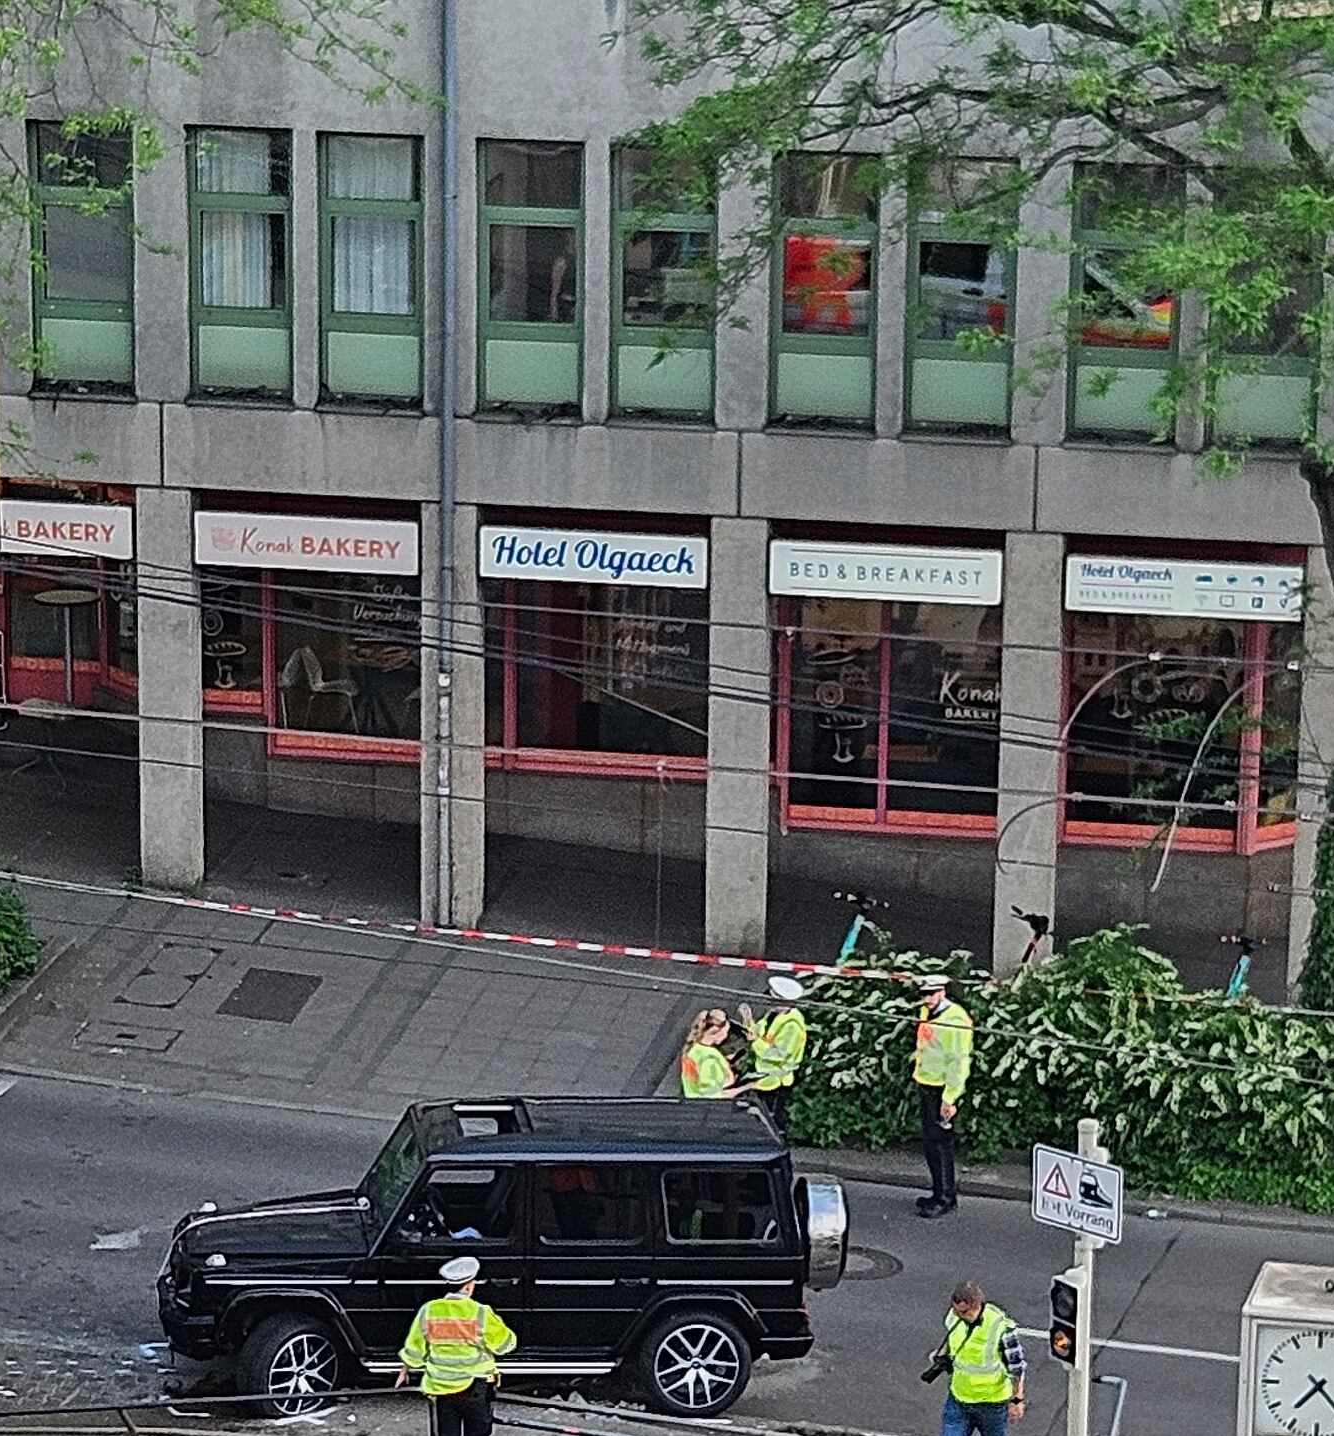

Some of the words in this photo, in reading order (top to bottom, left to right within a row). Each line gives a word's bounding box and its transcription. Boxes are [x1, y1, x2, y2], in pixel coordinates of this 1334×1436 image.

[16, 519, 115, 544] BAKERY
[240, 526, 294, 556] Konak
[300, 535, 401, 560] BAKERY
[492, 534, 568, 568] Hotel
[574, 539, 695, 580] Olgaeck
[1080, 563, 1114, 578] Hotel
[789, 562, 829, 580] BED
[836, 563, 847, 580] &
[856, 565, 983, 586] BREAKFAST
[1065, 1202, 1114, 1234] Vorrang
